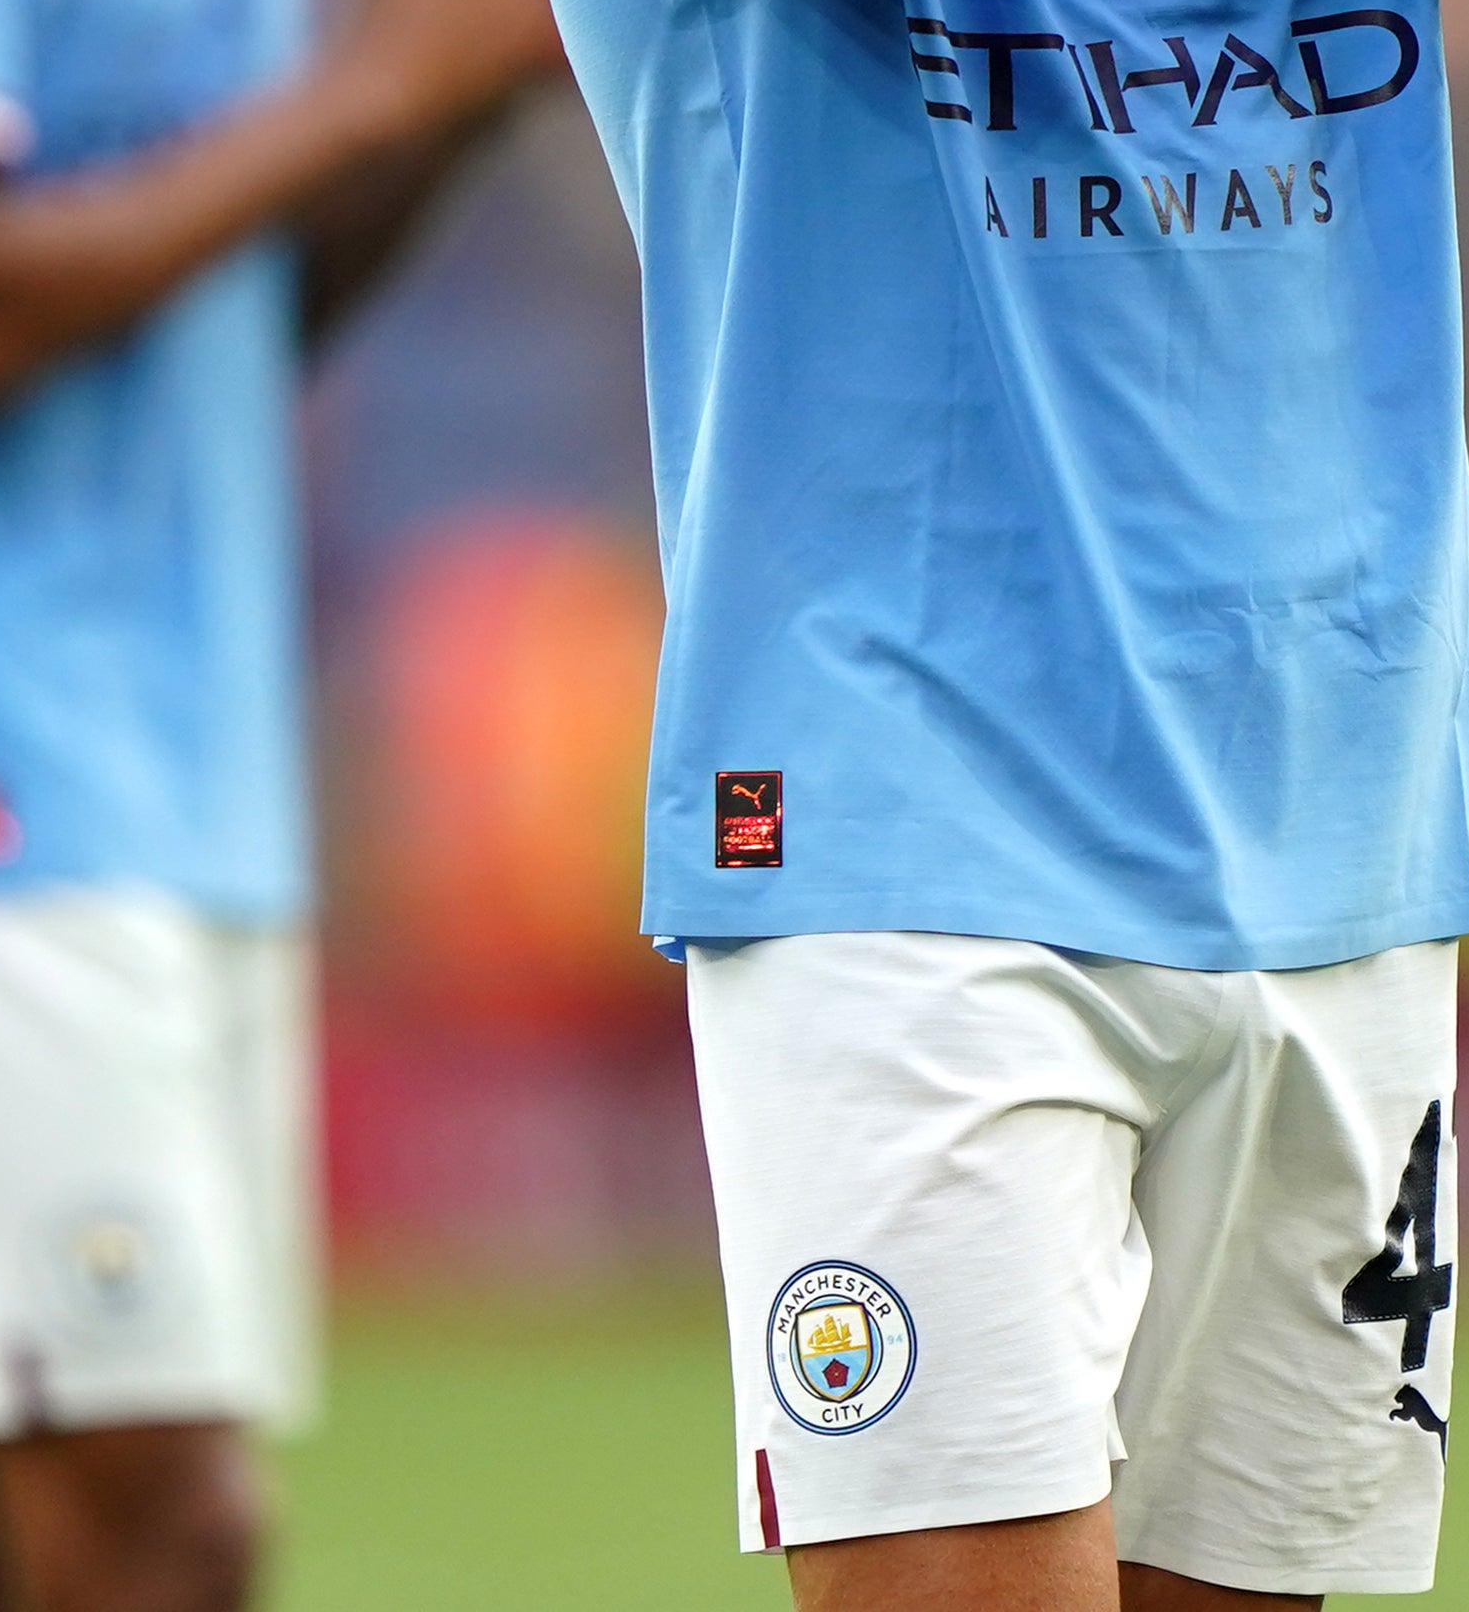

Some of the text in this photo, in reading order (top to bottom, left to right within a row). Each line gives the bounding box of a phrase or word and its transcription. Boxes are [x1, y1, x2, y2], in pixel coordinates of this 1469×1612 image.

[906, 8, 1420, 134] ETIHAD
[985, 160, 1334, 238] AIRWAYS
[1342, 1099, 1452, 1372] 4
[778, 1275, 892, 1333] MANCHESTER
[821, 1403, 864, 1423] CITY
